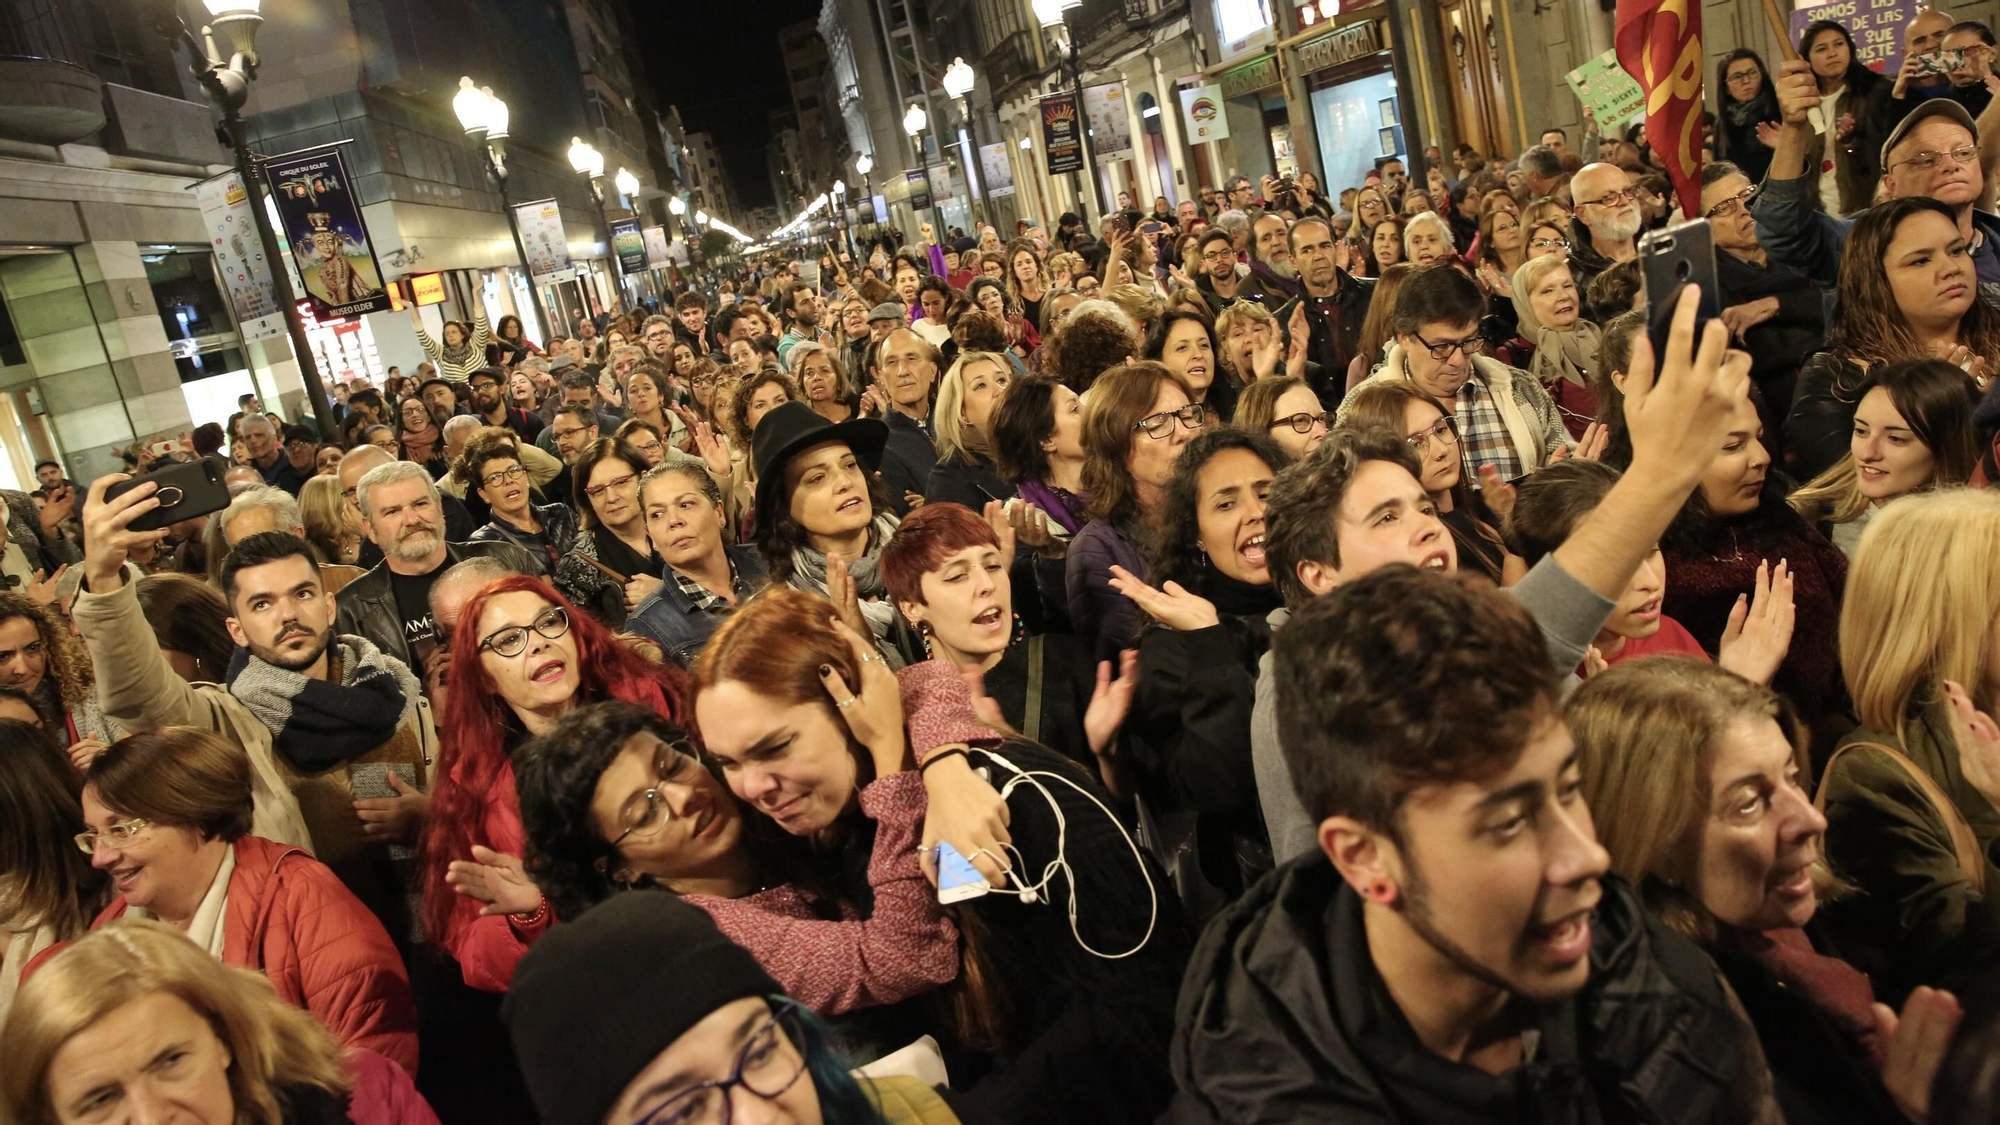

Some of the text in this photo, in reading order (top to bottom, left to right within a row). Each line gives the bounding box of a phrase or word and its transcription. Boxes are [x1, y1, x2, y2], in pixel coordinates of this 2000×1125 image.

[1807, 1, 1857, 21] SOMOS
[1852, 14, 1870, 31] DE
[1876, 8, 1904, 25] LAS
[1856, 41, 1896, 60] DISTE
[279, 162, 329, 177] CIRQUE DU SOLEIL
[278, 172, 341, 208] TOTEM
[329, 301, 375, 317] MUSEO ELDER
